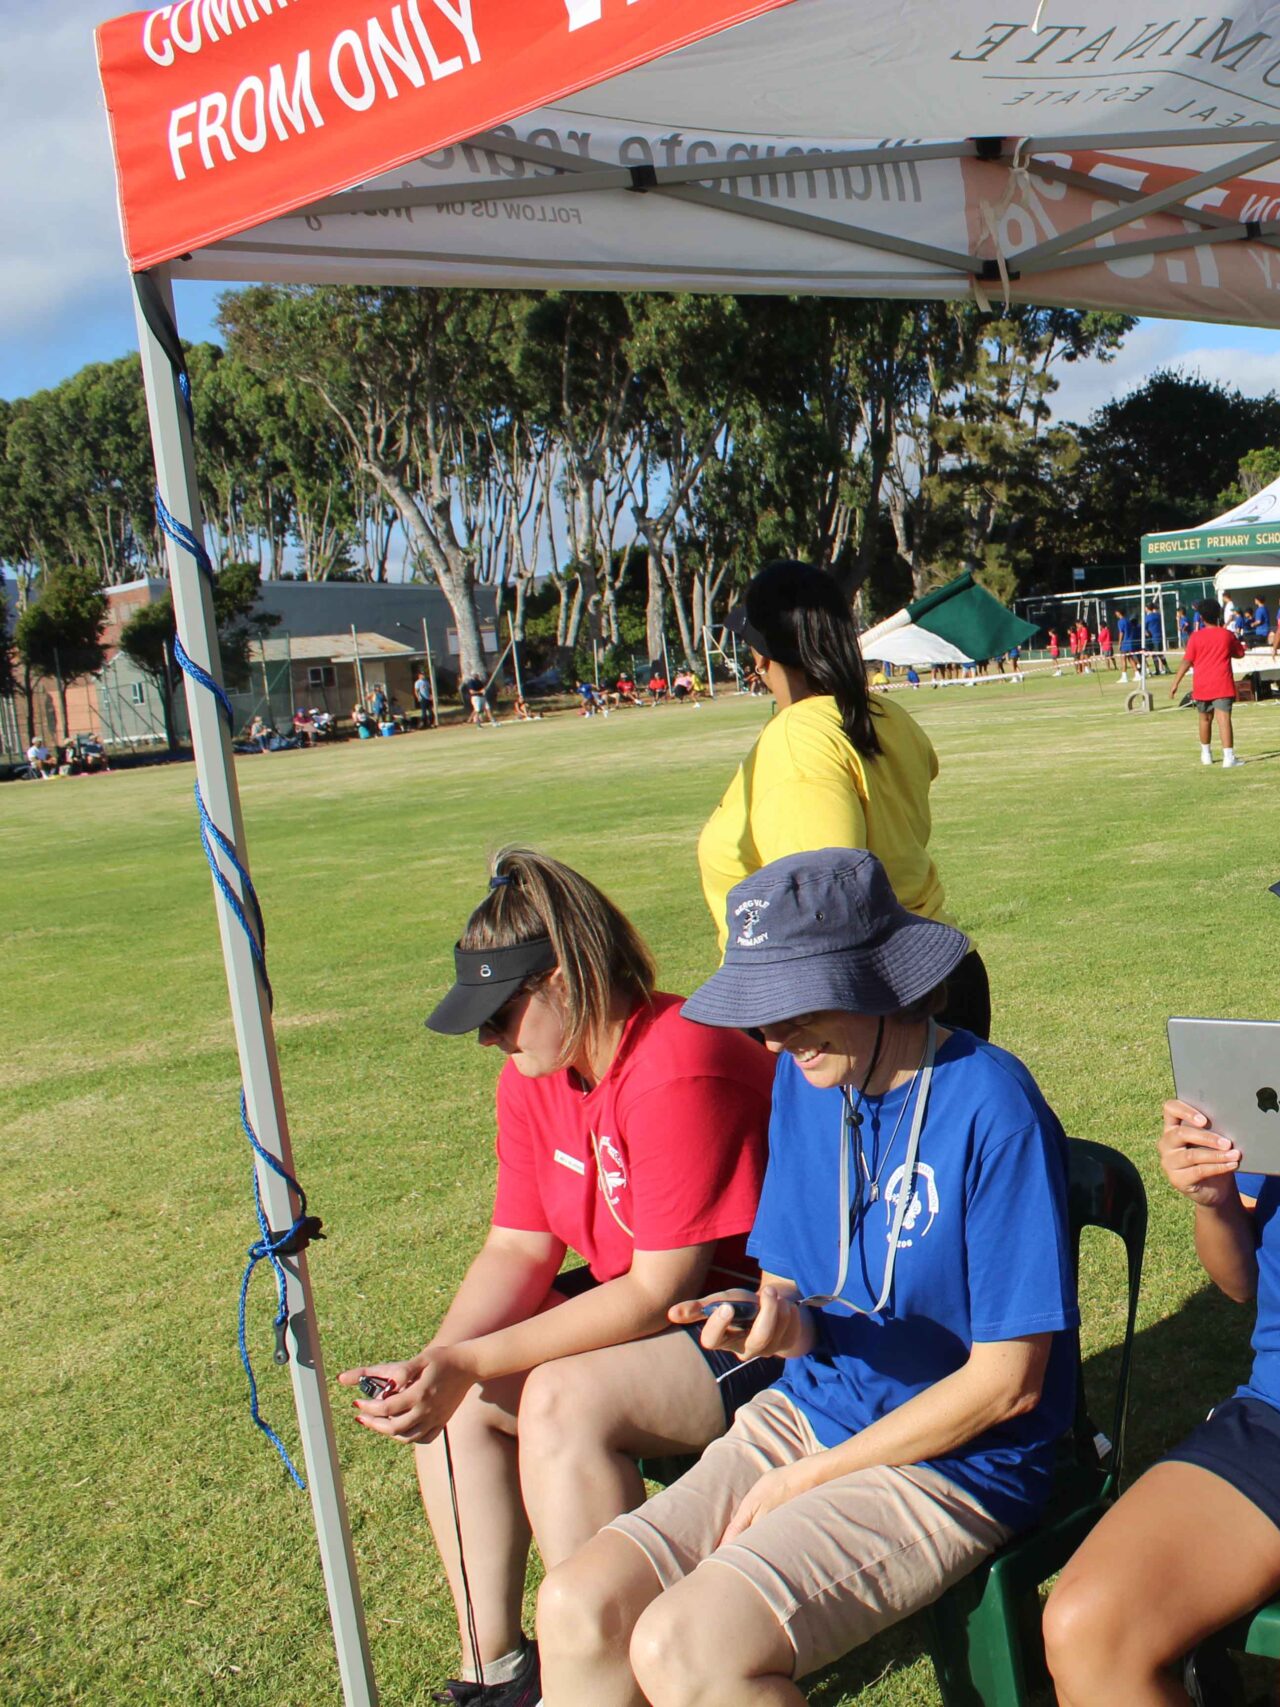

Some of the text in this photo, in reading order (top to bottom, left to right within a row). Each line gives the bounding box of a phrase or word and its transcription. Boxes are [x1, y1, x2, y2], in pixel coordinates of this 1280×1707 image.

[168, 0, 482, 181] FROM ONLY
[1148, 538, 1201, 554] BERGVLIET
[1207, 534, 1250, 548] PRIMARY
